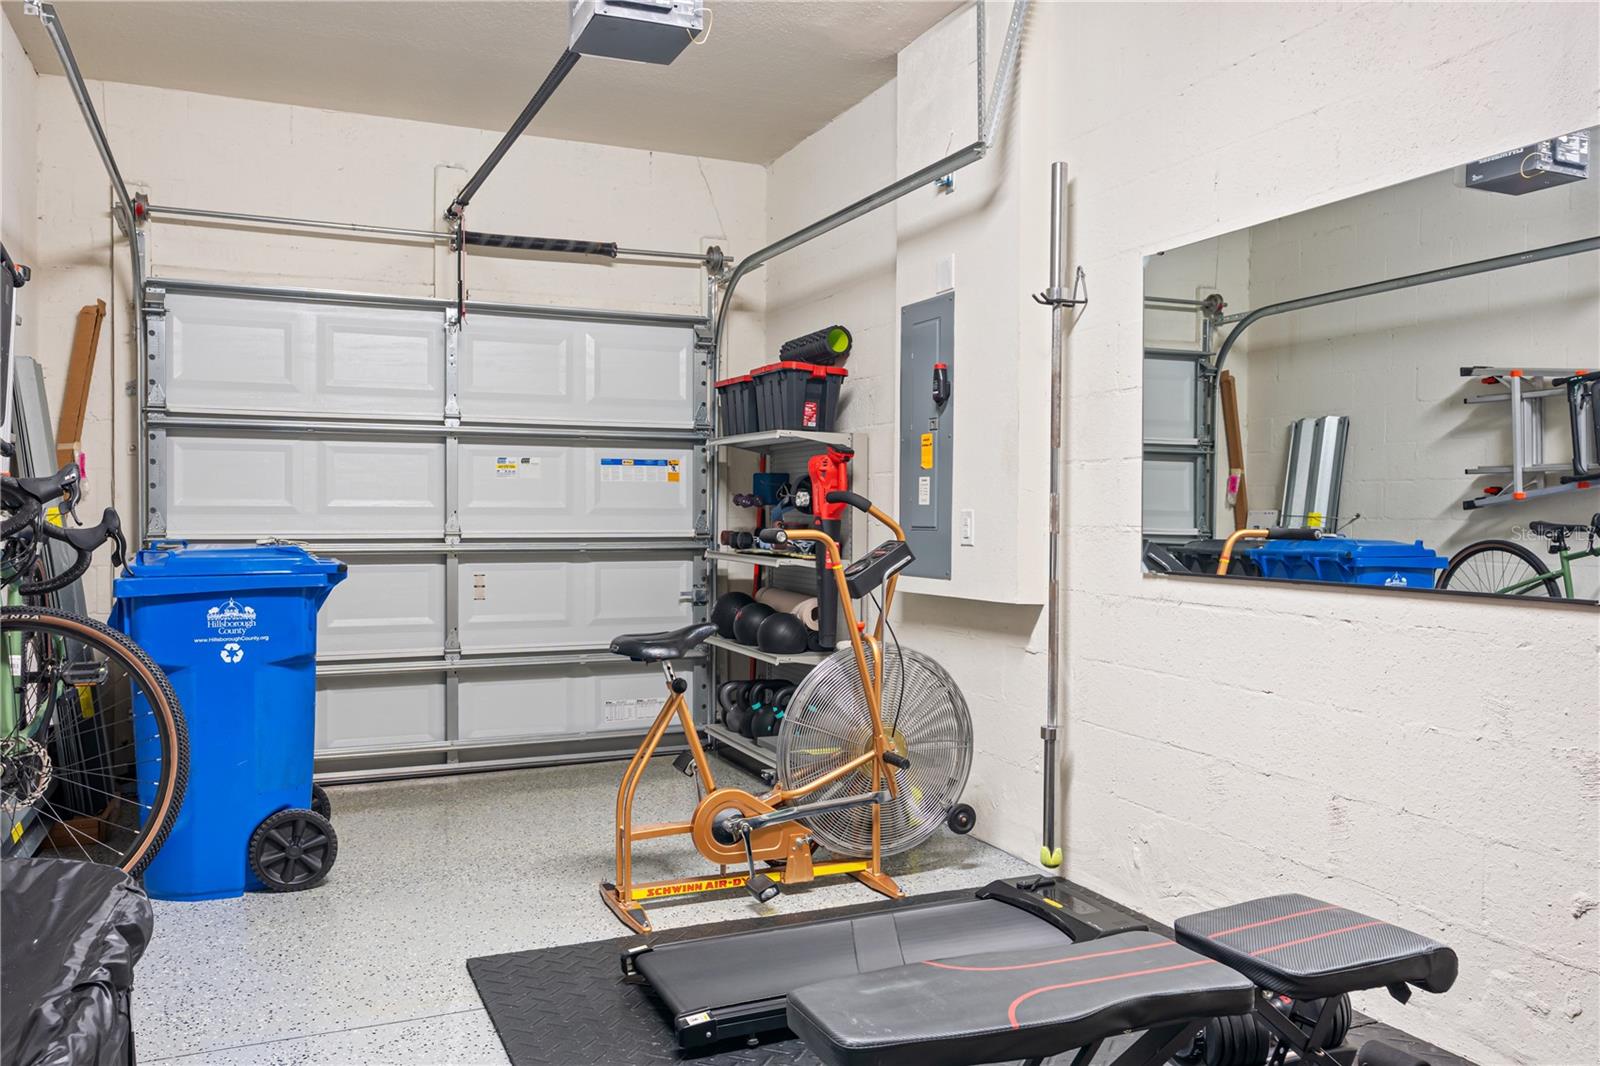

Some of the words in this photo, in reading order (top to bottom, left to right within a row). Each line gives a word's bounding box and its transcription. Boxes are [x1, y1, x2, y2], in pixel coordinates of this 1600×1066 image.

[207, 619, 256, 629] Hillsborough
[218, 627, 247, 636] County
[646, 883, 702, 897] SCHWINN
[705, 877, 750, 889] AIR-DY
